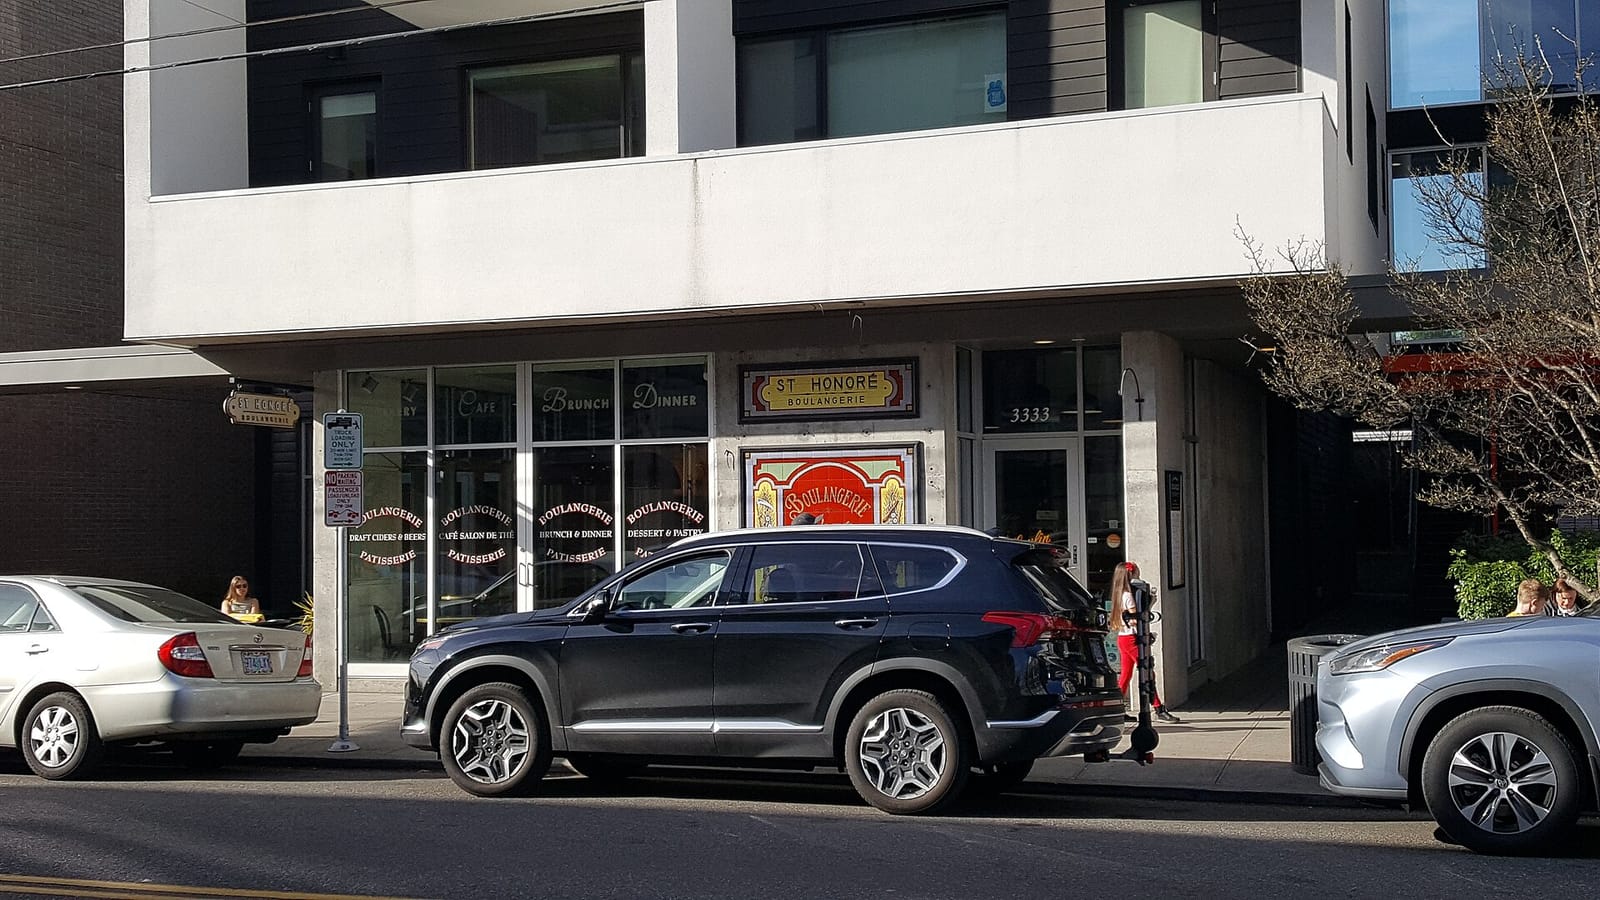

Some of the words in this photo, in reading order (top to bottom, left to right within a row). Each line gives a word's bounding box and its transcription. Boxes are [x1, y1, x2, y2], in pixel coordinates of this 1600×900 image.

[776, 378, 795, 392] ST
[812, 373, 878, 392] HONORÉ
[238, 397, 249, 409] ST
[542, 386, 610, 413] BRUNCH
[632, 382, 697, 409] DINNER
[788, 395, 865, 406] BOULANGERIE
[1010, 407, 1050, 423] 3333
[326, 472, 337, 485] NO
[785, 486, 872, 519] BOULANGERIE
[358, 506, 423, 528] OULANGERIE
[440, 504, 513, 527] BOULANGERIE
[538, 502, 614, 526] BOULANGERIE
[626, 501, 704, 525] BOULANGERIE
[349, 533, 371, 542] DRAFT
[372, 533, 396, 542] CIDERS
[404, 532, 426, 541] BEERS
[439, 530, 458, 540] CAFÉ
[459, 531, 485, 540] SALON
[486, 531, 497, 540] DE
[539, 530, 572, 539] BRUNCH
[581, 530, 613, 538] DINNER
[627, 529, 664, 538] DESSERT
[673, 528, 703, 537] PASTRY
[359, 549, 417, 566] PATISSERIE
[447, 548, 506, 564] PATISSERIE
[546, 547, 607, 563] PATISSERIE
